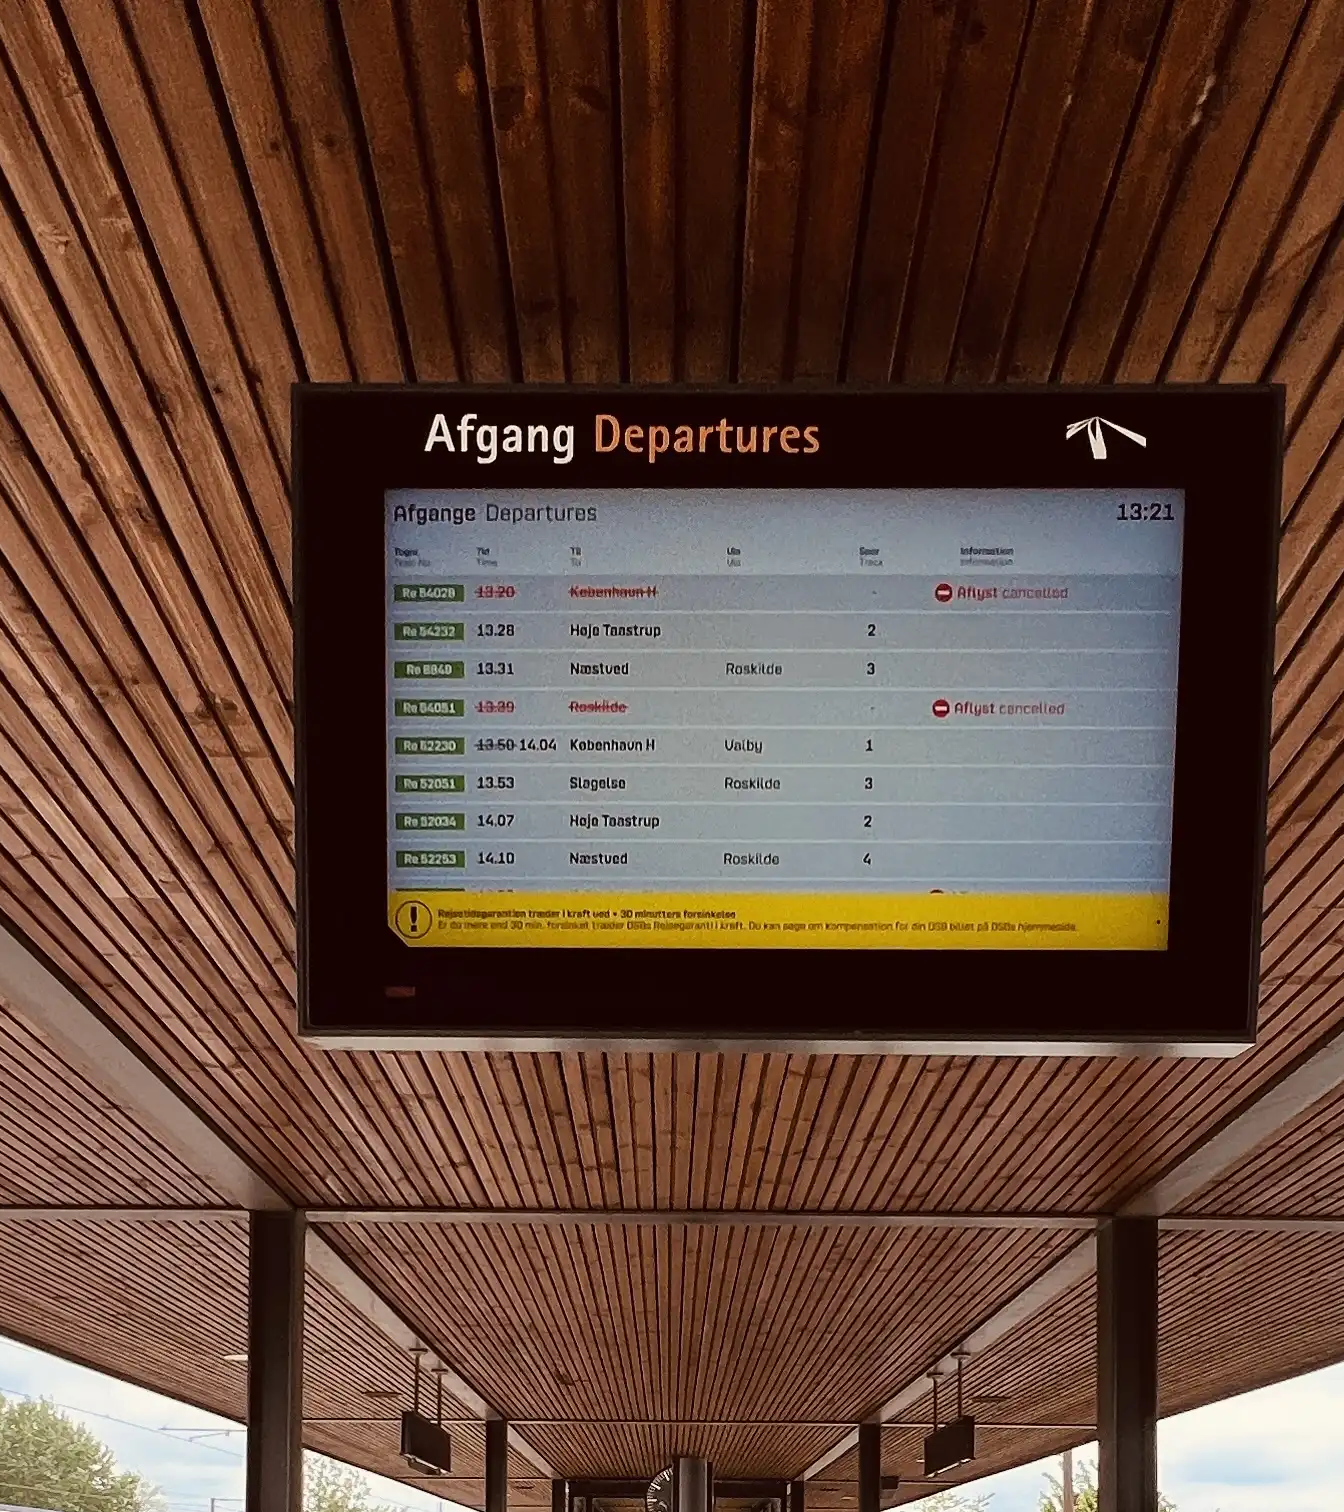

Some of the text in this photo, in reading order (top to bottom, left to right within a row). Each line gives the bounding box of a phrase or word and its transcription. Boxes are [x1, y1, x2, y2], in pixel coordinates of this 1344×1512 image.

[424, 413, 820, 465] Afgang Departures
[393, 503, 598, 526] Afgange Departures
[1116, 503, 1175, 522] 13:21
[959, 546, 1014, 556] Information
[477, 586, 516, 599] 13.20
[957, 586, 998, 601] Aflyst
[1002, 586, 1069, 600] cancelled
[477, 624, 516, 638] 13.28
[570, 624, 600, 640] Høje
[603, 624, 662, 640] Taastrup
[867, 624, 876, 637] 2
[477, 662, 515, 675] 13.31
[570, 662, 630, 675] Næstved
[725, 662, 783, 676] Roskilde
[866, 663, 875, 676] 3
[570, 701, 627, 713] Roskilde
[954, 702, 995, 717] Aflyst
[999, 702, 1065, 715] cancelled
[477, 739, 516, 751] 13.50
[519, 739, 557, 751] 14.04
[570, 739, 643, 752] København
[645, 740, 656, 751] H
[724, 739, 763, 754] Valby
[865, 739, 874, 752] 1
[477, 776, 515, 789] 13.53
[569, 776, 627, 791] Slagelse
[724, 776, 781, 790] Roskilde
[864, 777, 874, 790] 3
[477, 814, 515, 827] 14.07
[569, 814, 599, 830] Høje
[603, 814, 661, 830] Taastrup
[863, 815, 873, 828] 2
[477, 852, 516, 865] 14.10
[569, 852, 629, 865] Næstved
[723, 852, 780, 866] Roskilde
[862, 853, 872, 865] 4
[566, 909, 591, 918] kraft
[592, 909, 610, 918] ved
[620, 910, 634, 919] 30
[634, 910, 682, 919] minutters
[683, 910, 736, 919] forsinkelse
[510, 920, 523, 930] 30
[748, 921, 762, 931] Du
[763, 921, 780, 931] kan
[825, 921, 893, 933] kompensation
[895, 921, 909, 931] for
[911, 921, 926, 931] din
[977, 921, 989, 934] på
